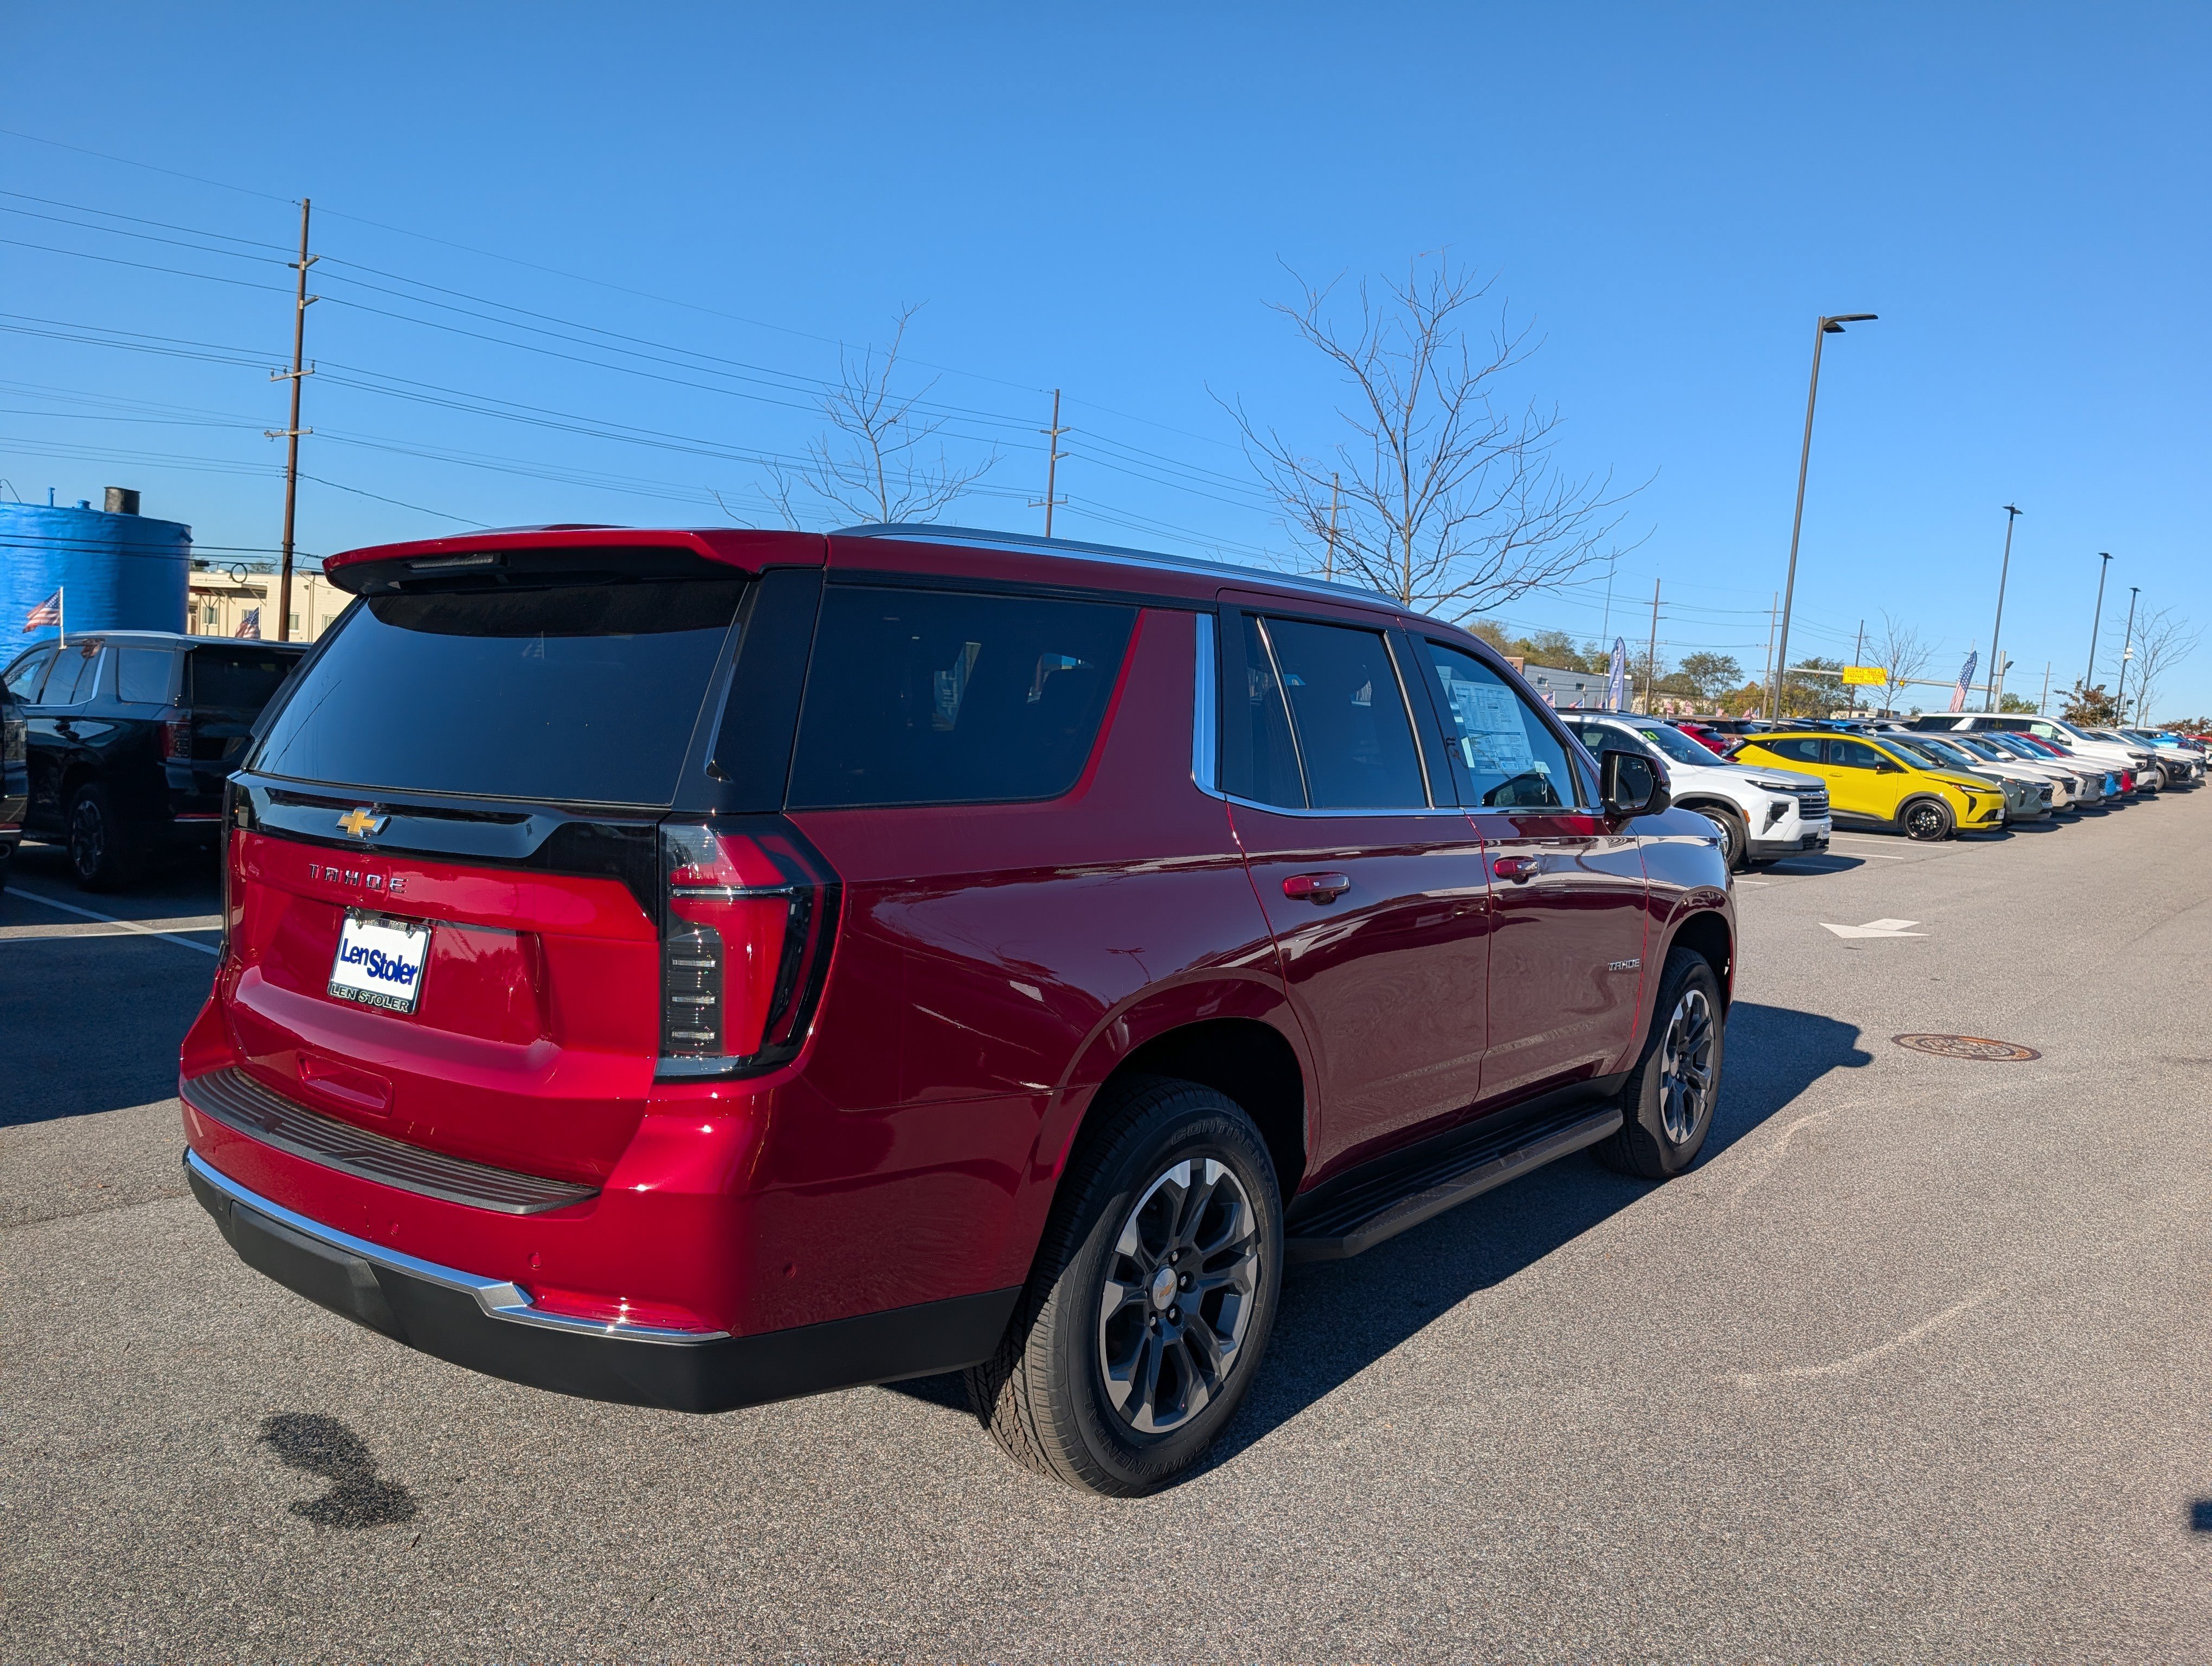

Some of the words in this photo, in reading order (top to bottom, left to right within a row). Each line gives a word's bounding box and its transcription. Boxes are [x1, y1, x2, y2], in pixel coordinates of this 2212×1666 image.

[308, 863, 406, 894] TAHOE
[1607, 958, 1640, 971] TAHOE
[330, 984, 357, 1000] LEN
[358, 990, 409, 1013] STOLER
